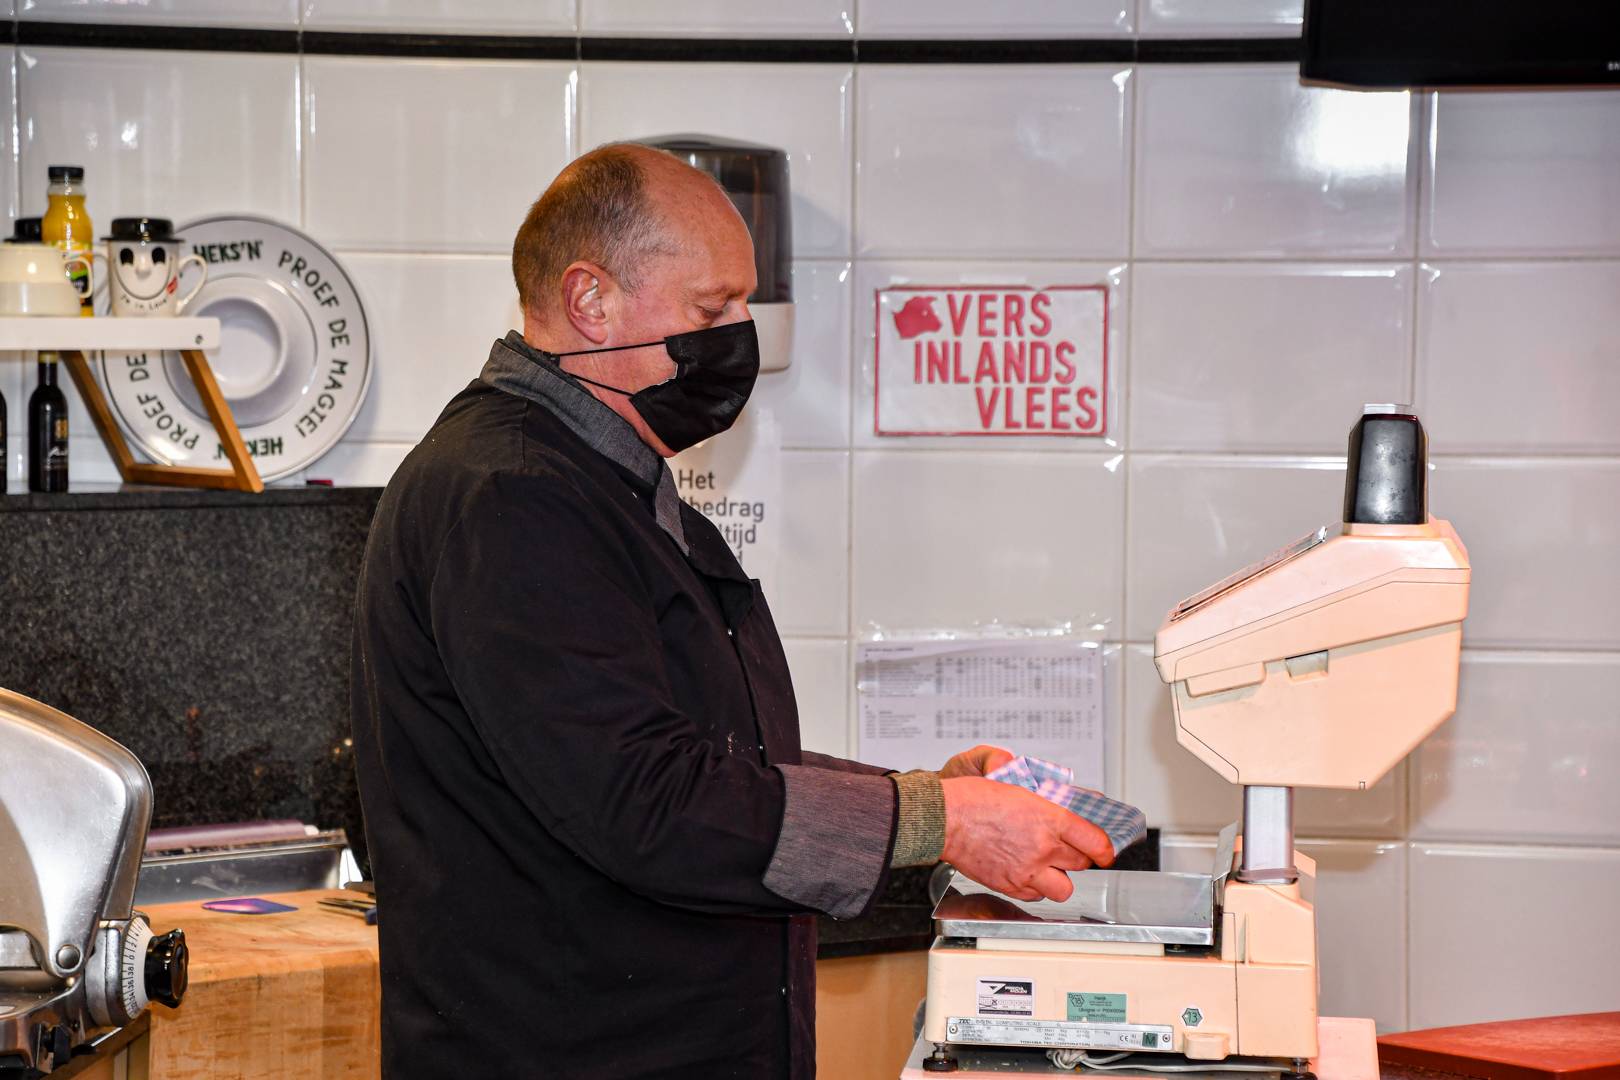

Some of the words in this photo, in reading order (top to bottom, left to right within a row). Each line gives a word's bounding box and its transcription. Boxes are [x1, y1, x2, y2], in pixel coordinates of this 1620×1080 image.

[277, 250, 339, 310] PROEF
[328, 318, 351, 348] DE
[946, 293, 1052, 337] VERS
[126, 353, 150, 382] DE
[914, 340, 1077, 384] INLANDS
[295, 358, 349, 438] MAGIE!
[975, 386, 1098, 430] VLEES
[137, 394, 200, 450] PROEF
[678, 469, 715, 489] Het
[682, 497, 765, 523] bedrag
[718, 523, 757, 549] tijd
